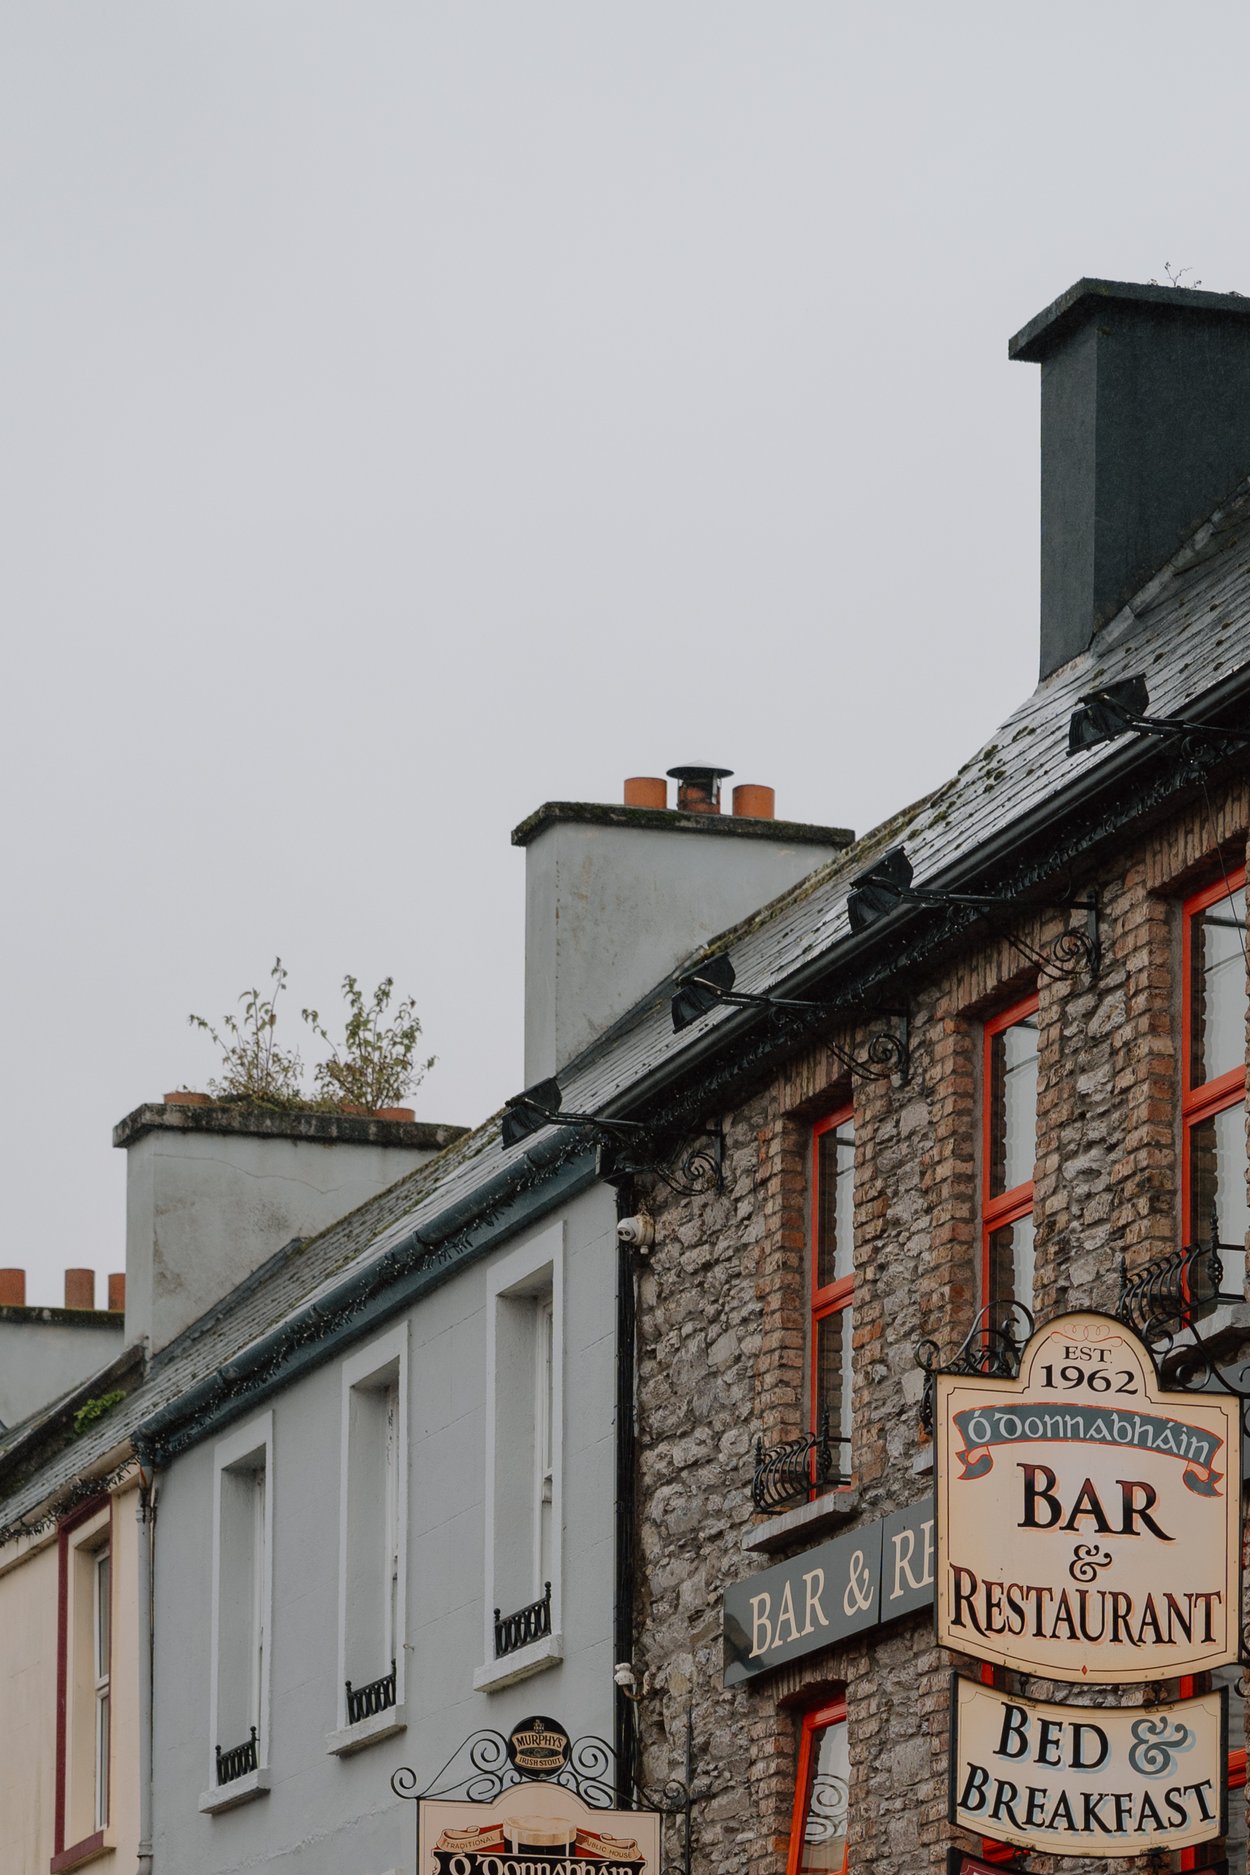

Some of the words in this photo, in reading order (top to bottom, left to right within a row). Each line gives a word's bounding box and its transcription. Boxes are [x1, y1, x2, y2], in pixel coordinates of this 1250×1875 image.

[1063, 1346, 1112, 1364] EST.
[1040, 1364, 1139, 1396] 1962
[1016, 1461, 1176, 1542] BAR
[1068, 1543, 1112, 1583] &
[749, 1568, 829, 1659] BAR
[843, 1550, 874, 1616] &
[950, 1561, 1221, 1648] RESTAURANT
[993, 1702, 1109, 1769] BED
[1128, 1715, 1188, 1776] &
[519, 1757, 538, 1766] IRISH
[539, 1757, 561, 1766] STOUT
[957, 1762, 1216, 1833] BREAKFAST
[444, 1836, 495, 1850] TRADITIONAL
[583, 1837, 607, 1853] PUBLIC
[609, 1849, 632, 1859] HOUSE
